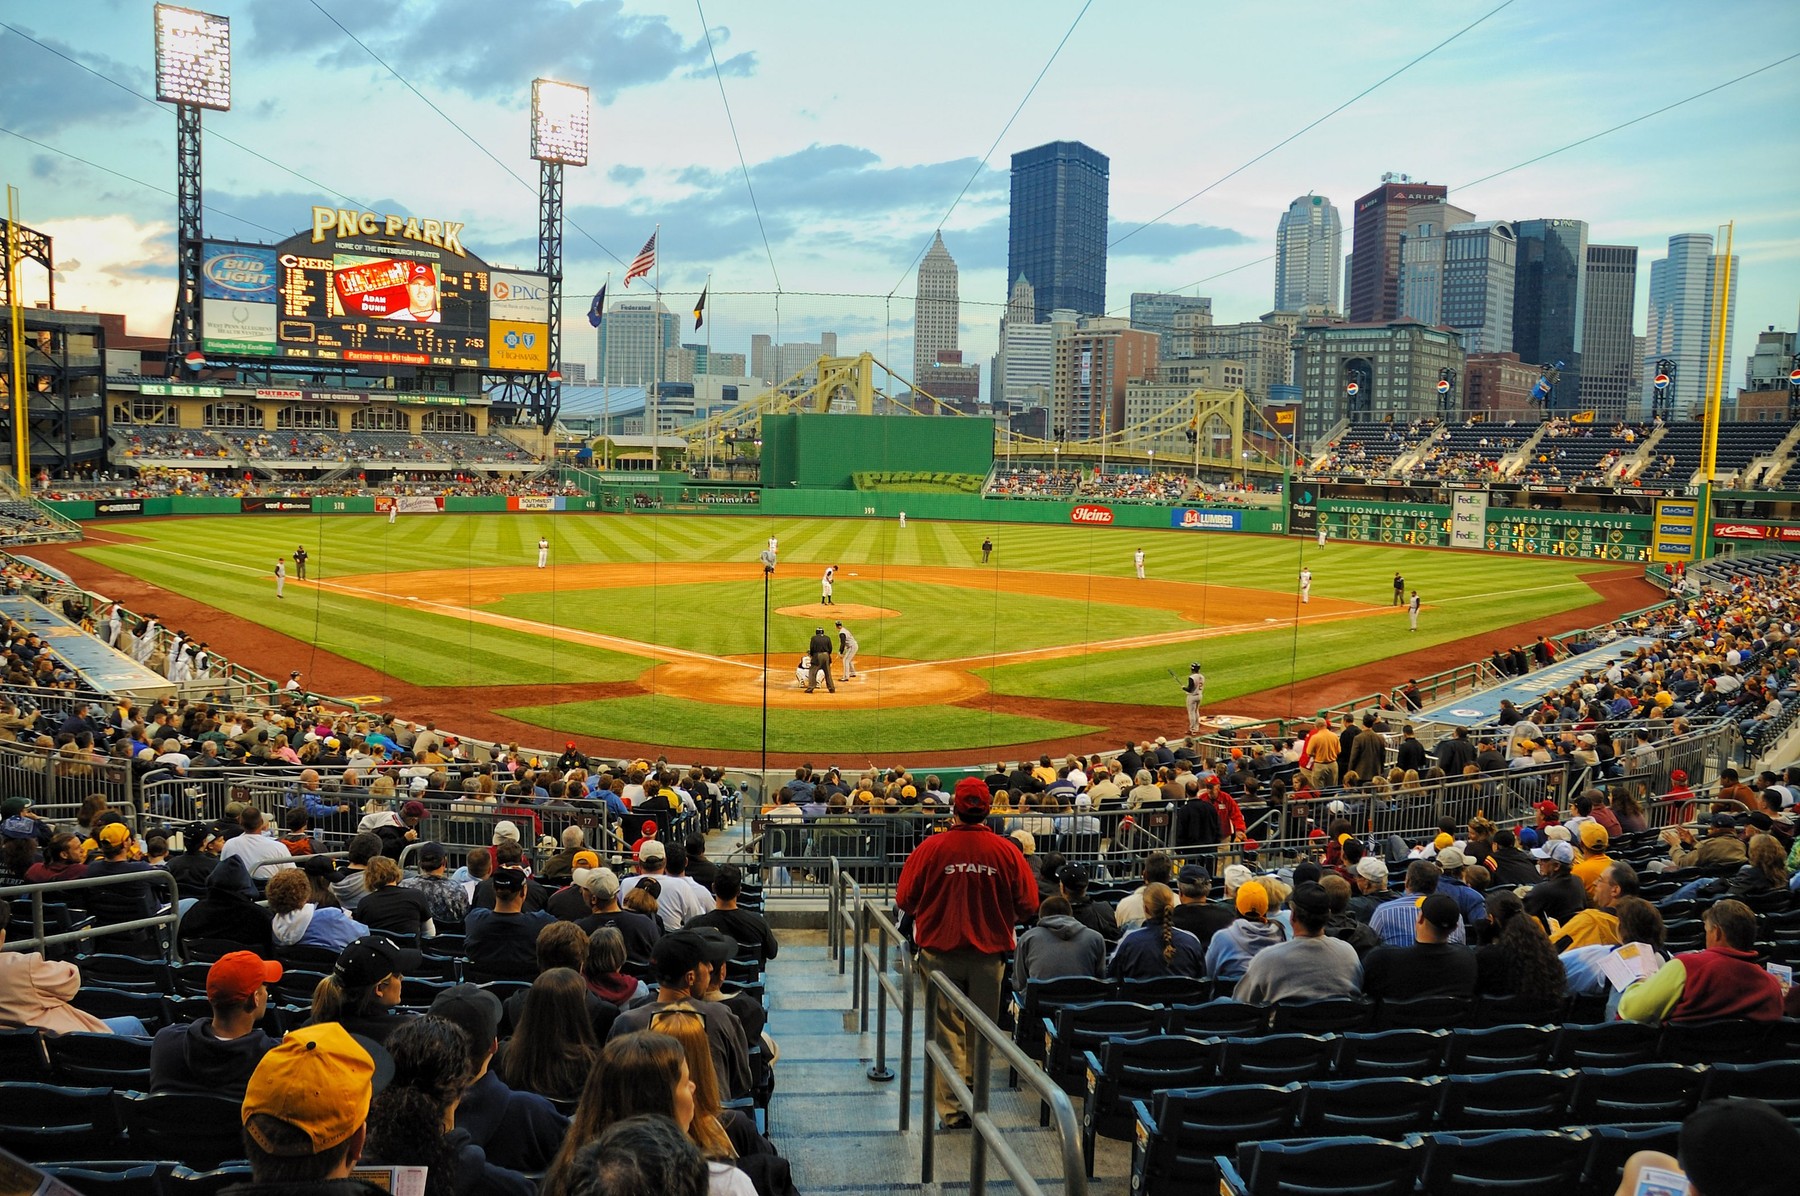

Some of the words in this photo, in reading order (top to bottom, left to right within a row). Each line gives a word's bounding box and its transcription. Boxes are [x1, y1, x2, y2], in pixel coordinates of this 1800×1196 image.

[312, 206, 379, 244] PNC
[385, 213, 466, 258] PARK
[377, 246, 415, 256] PITTSBURGH
[416, 250, 440, 259] PIRATES
[222, 259, 265, 272] BUD
[298, 257, 334, 270] REDS
[214, 270, 272, 284] LIGHT
[512, 285, 545, 300] PNC
[362, 303, 386, 312] DUNN
[357, 324, 366, 333] 0
[397, 326, 406, 336] 2
[426, 328, 434, 337] 2
[465, 338, 484, 348] 7:53
[348, 352, 383, 362] Partnering
[391, 354, 425, 364] Pittsburgh
[862, 472, 986, 492] PIRATES
[1684, 487, 1698, 495] 320
[265, 502, 292, 511] verizon
[1458, 496, 1481, 504] FedEx
[1073, 508, 1111, 521] Heinz
[1185, 513, 1198, 522] 84
[1201, 514, 1233, 524] LUMBER
[1331, 506, 1386, 515] NATIONAL
[1390, 509, 1434, 518] LEAGUE
[1457, 513, 1480, 522] FedEx
[1503, 516, 1572, 526] AMERICAN
[1577, 520, 1632, 529] LEAGUE
[1456, 531, 1479, 540] FedEx
[944, 863, 998, 876] STAFF
